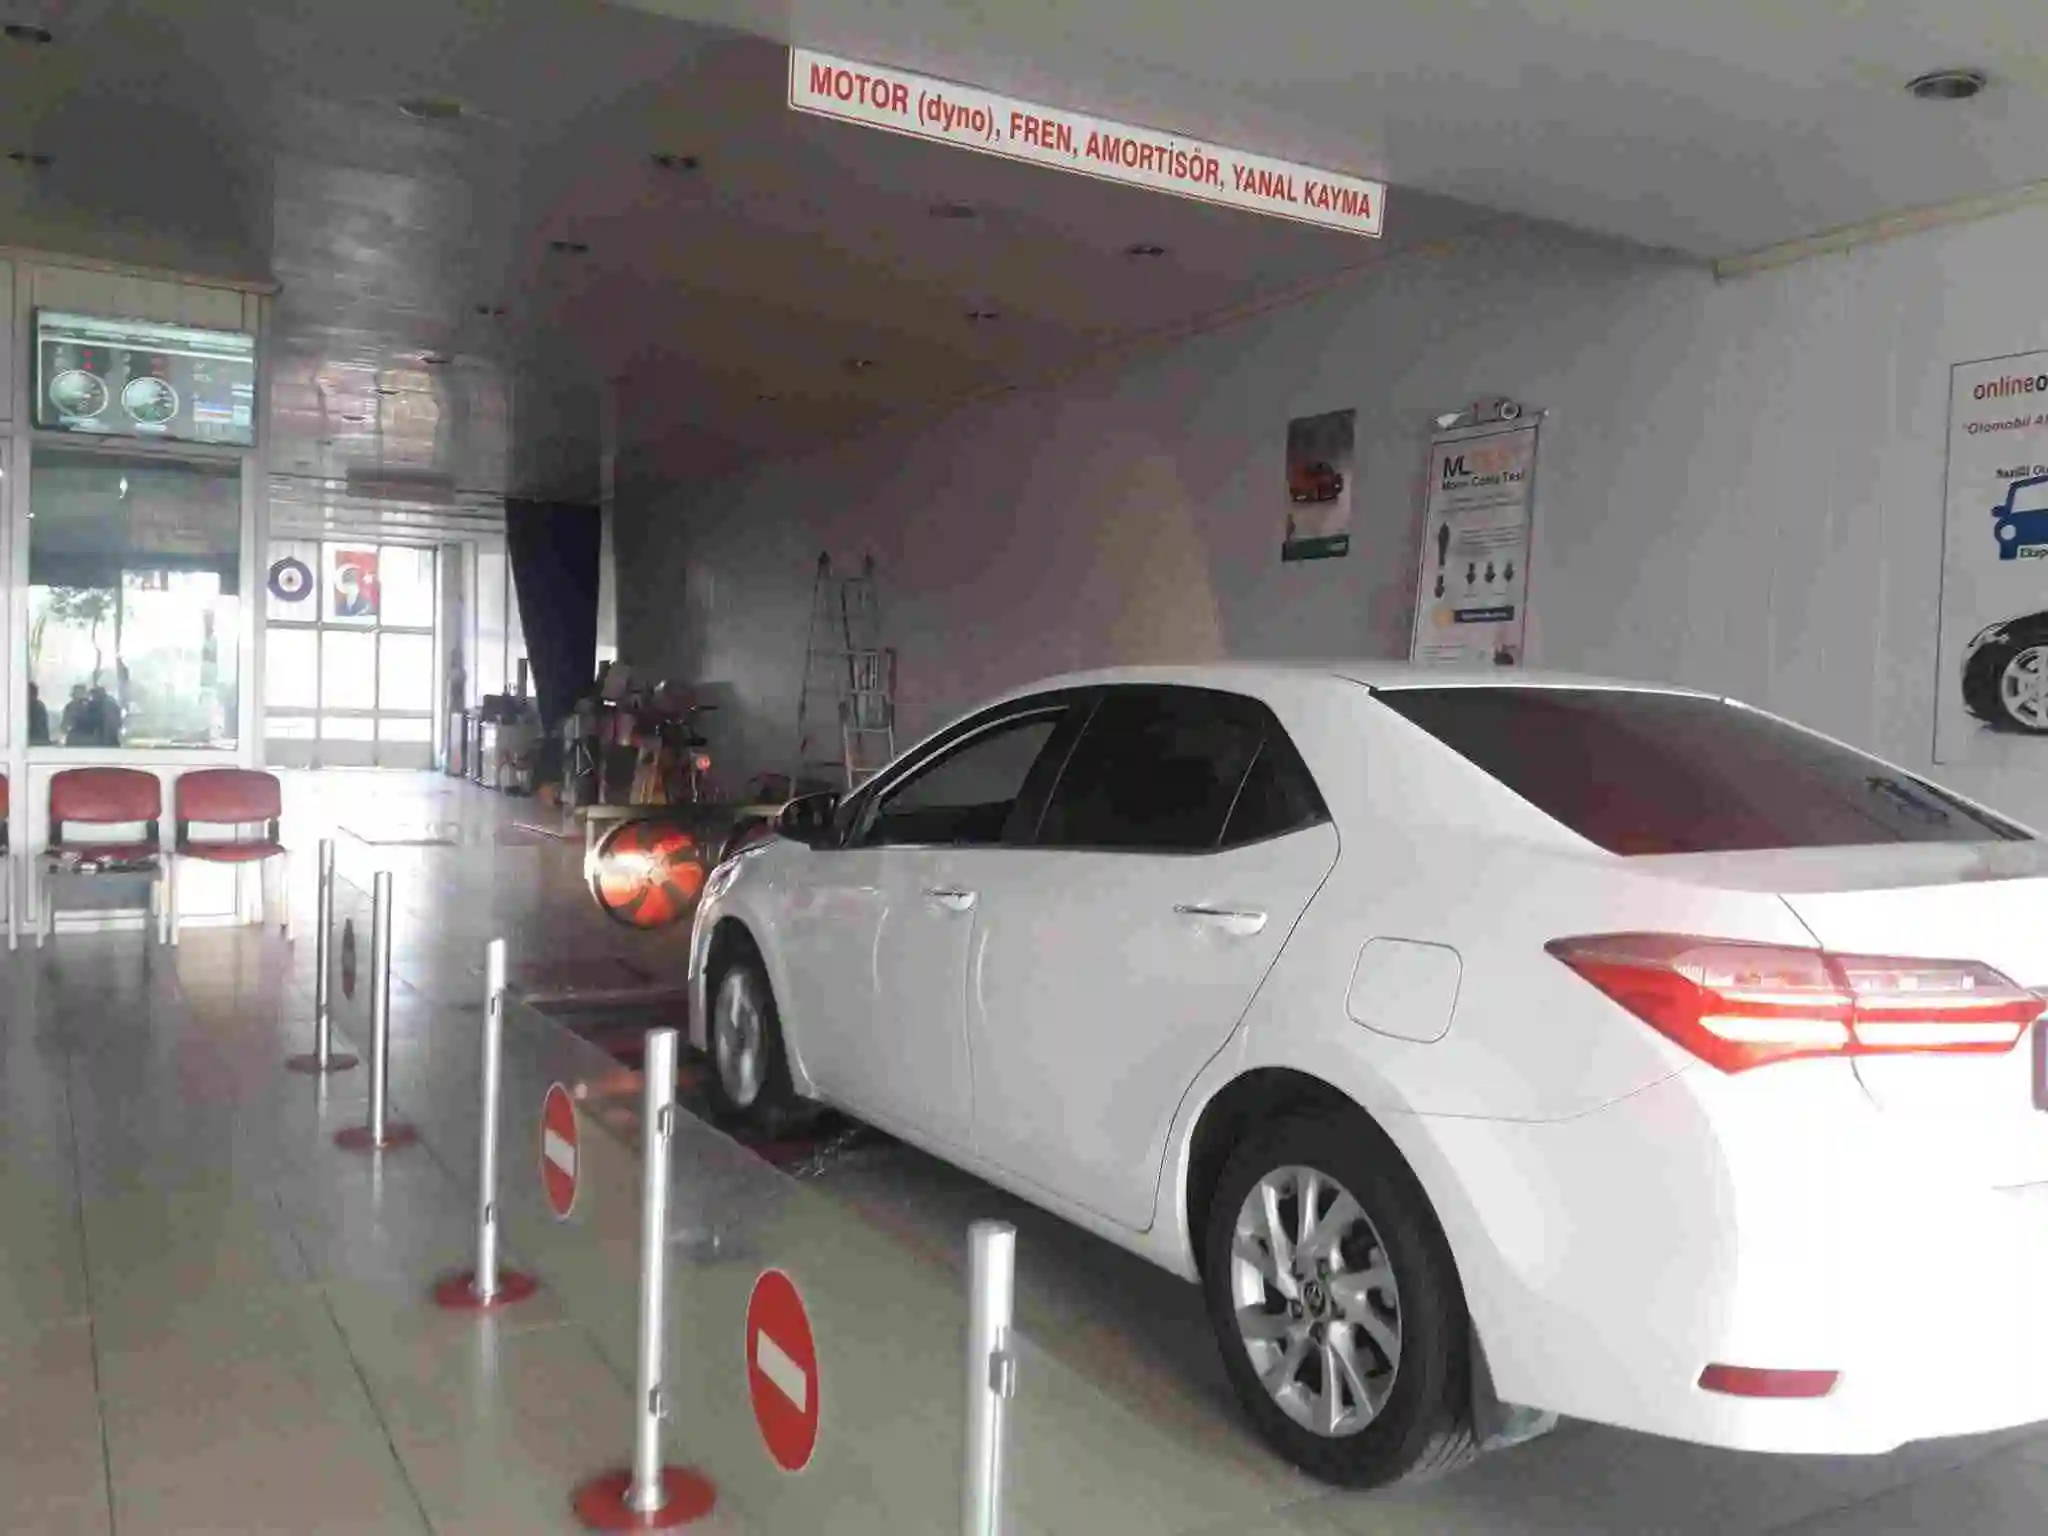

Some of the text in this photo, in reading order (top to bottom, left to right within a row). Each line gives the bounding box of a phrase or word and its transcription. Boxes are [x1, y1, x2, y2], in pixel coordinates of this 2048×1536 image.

[810, 62, 1371, 219] MOTOR (dyno), FREN, AMORTİSÖR, YANAL KAYMA
